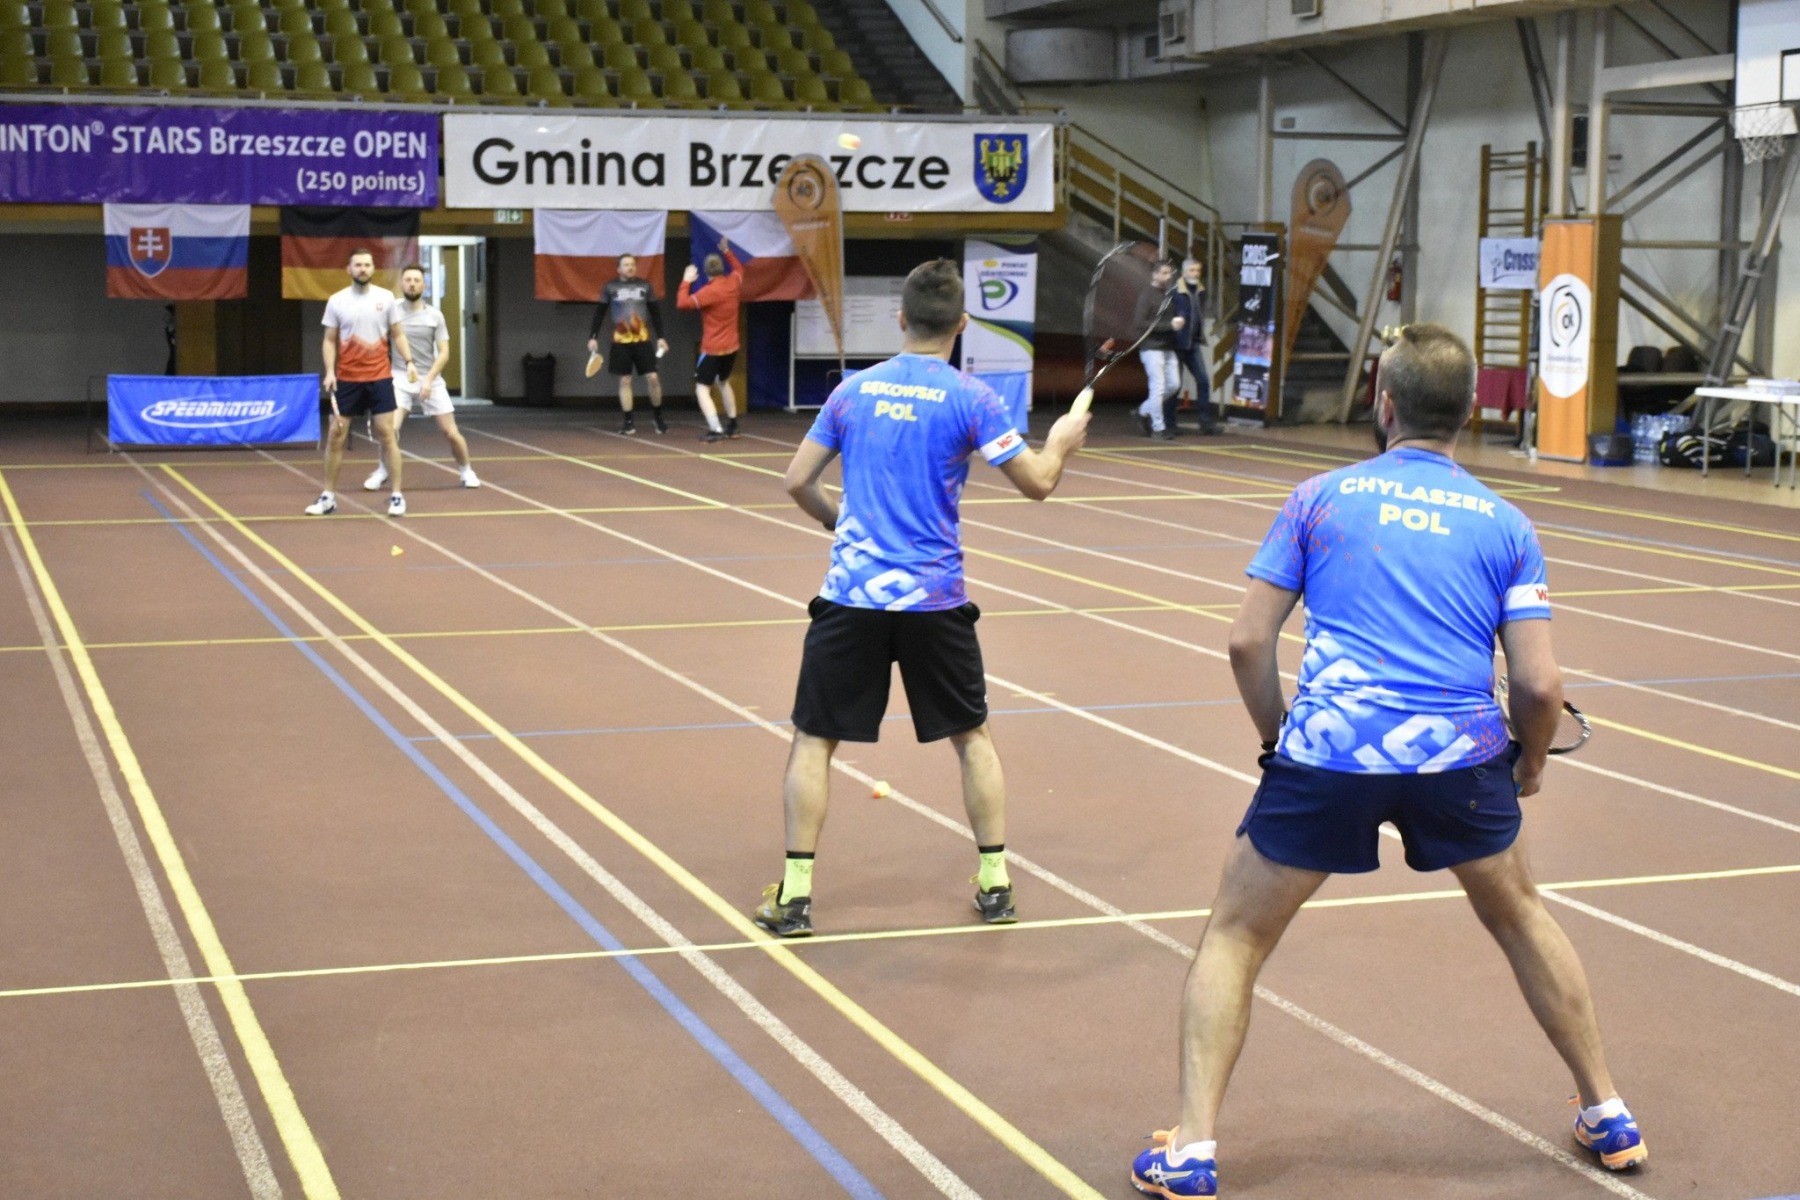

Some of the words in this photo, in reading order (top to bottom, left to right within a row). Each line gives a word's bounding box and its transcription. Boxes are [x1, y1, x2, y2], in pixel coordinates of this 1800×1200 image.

[112, 126, 202, 154] STARS
[210, 127, 346, 157] Brzeszcze
[353, 130, 427, 159] OPEN
[472, 137, 665, 187] Gmina
[689, 142, 951, 191] Brzezcze
[296, 168, 347, 194] (250
[351, 169, 425, 196] points)
[859, 380, 947, 403] SĘKOWSKI
[874, 400, 918, 422] POL
[1340, 477, 1496, 518] CHYLASZEK
[1379, 503, 1450, 536] POL
